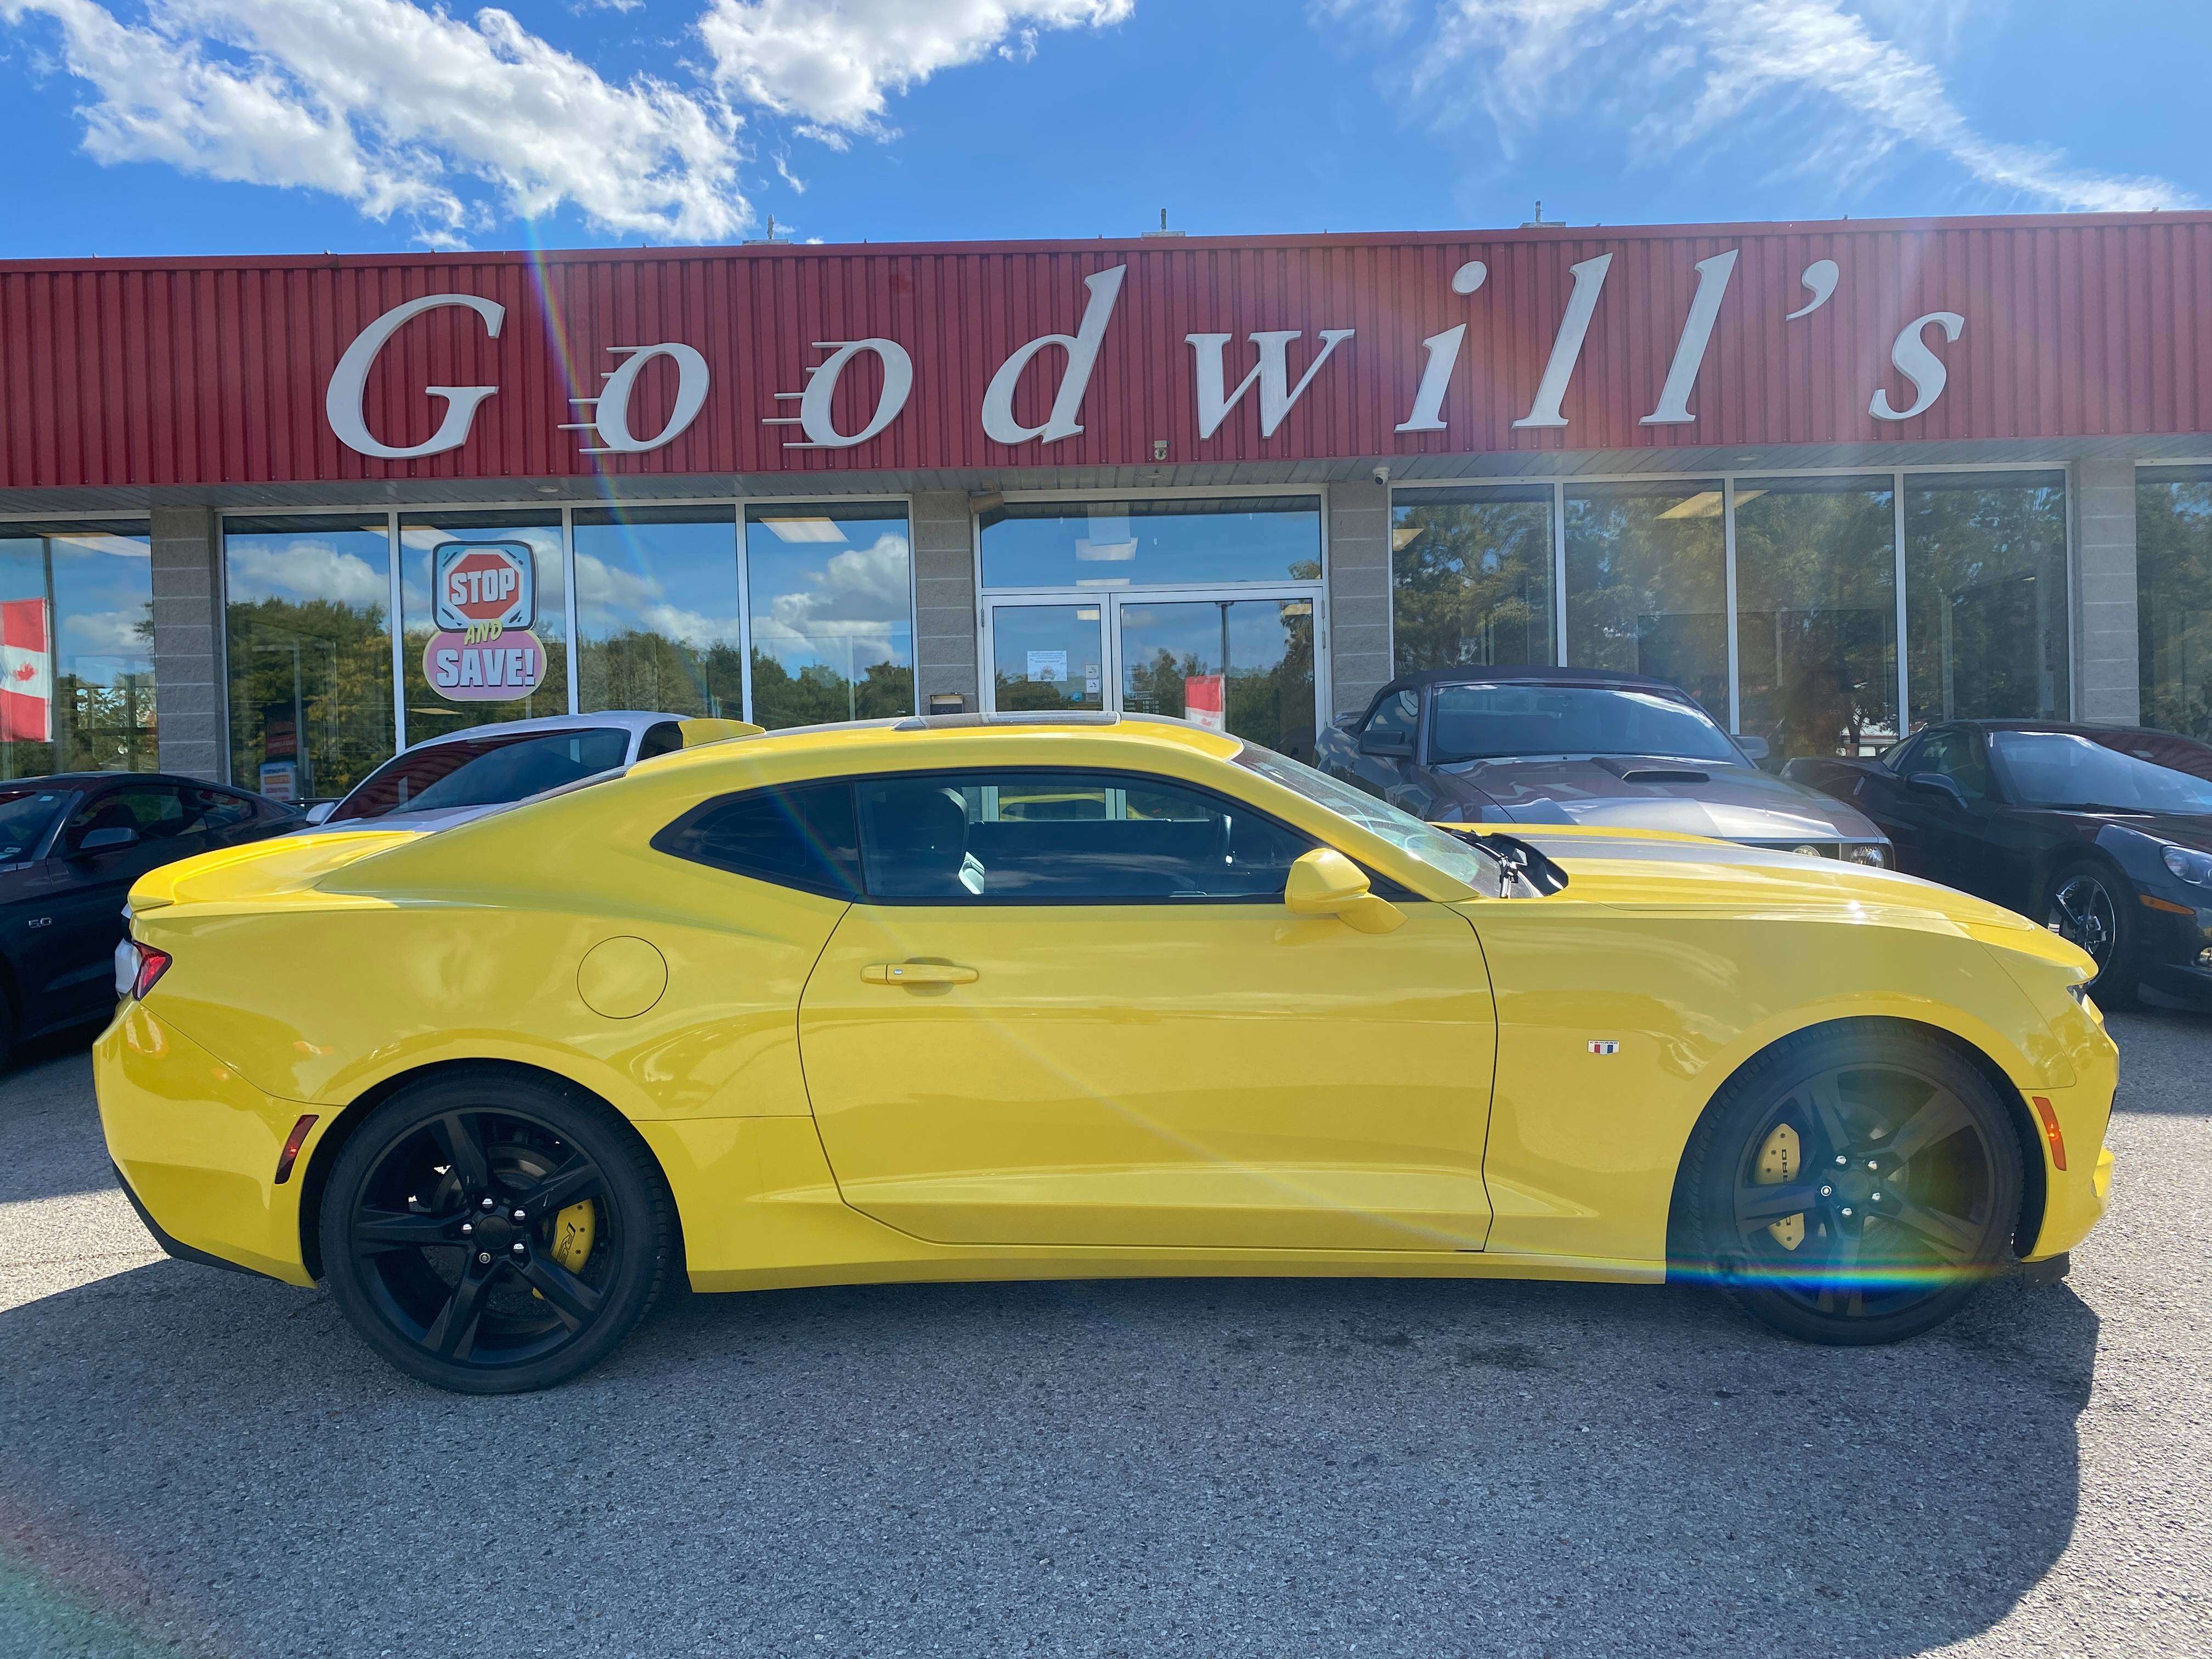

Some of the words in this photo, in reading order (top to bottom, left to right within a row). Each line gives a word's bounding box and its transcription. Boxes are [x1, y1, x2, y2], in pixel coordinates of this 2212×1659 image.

[325, 249, 1966, 460] Goodwill's
[450, 567, 516, 606] STOP
[464, 619, 503, 646] AND
[436, 648, 535, 687] SAVE!
